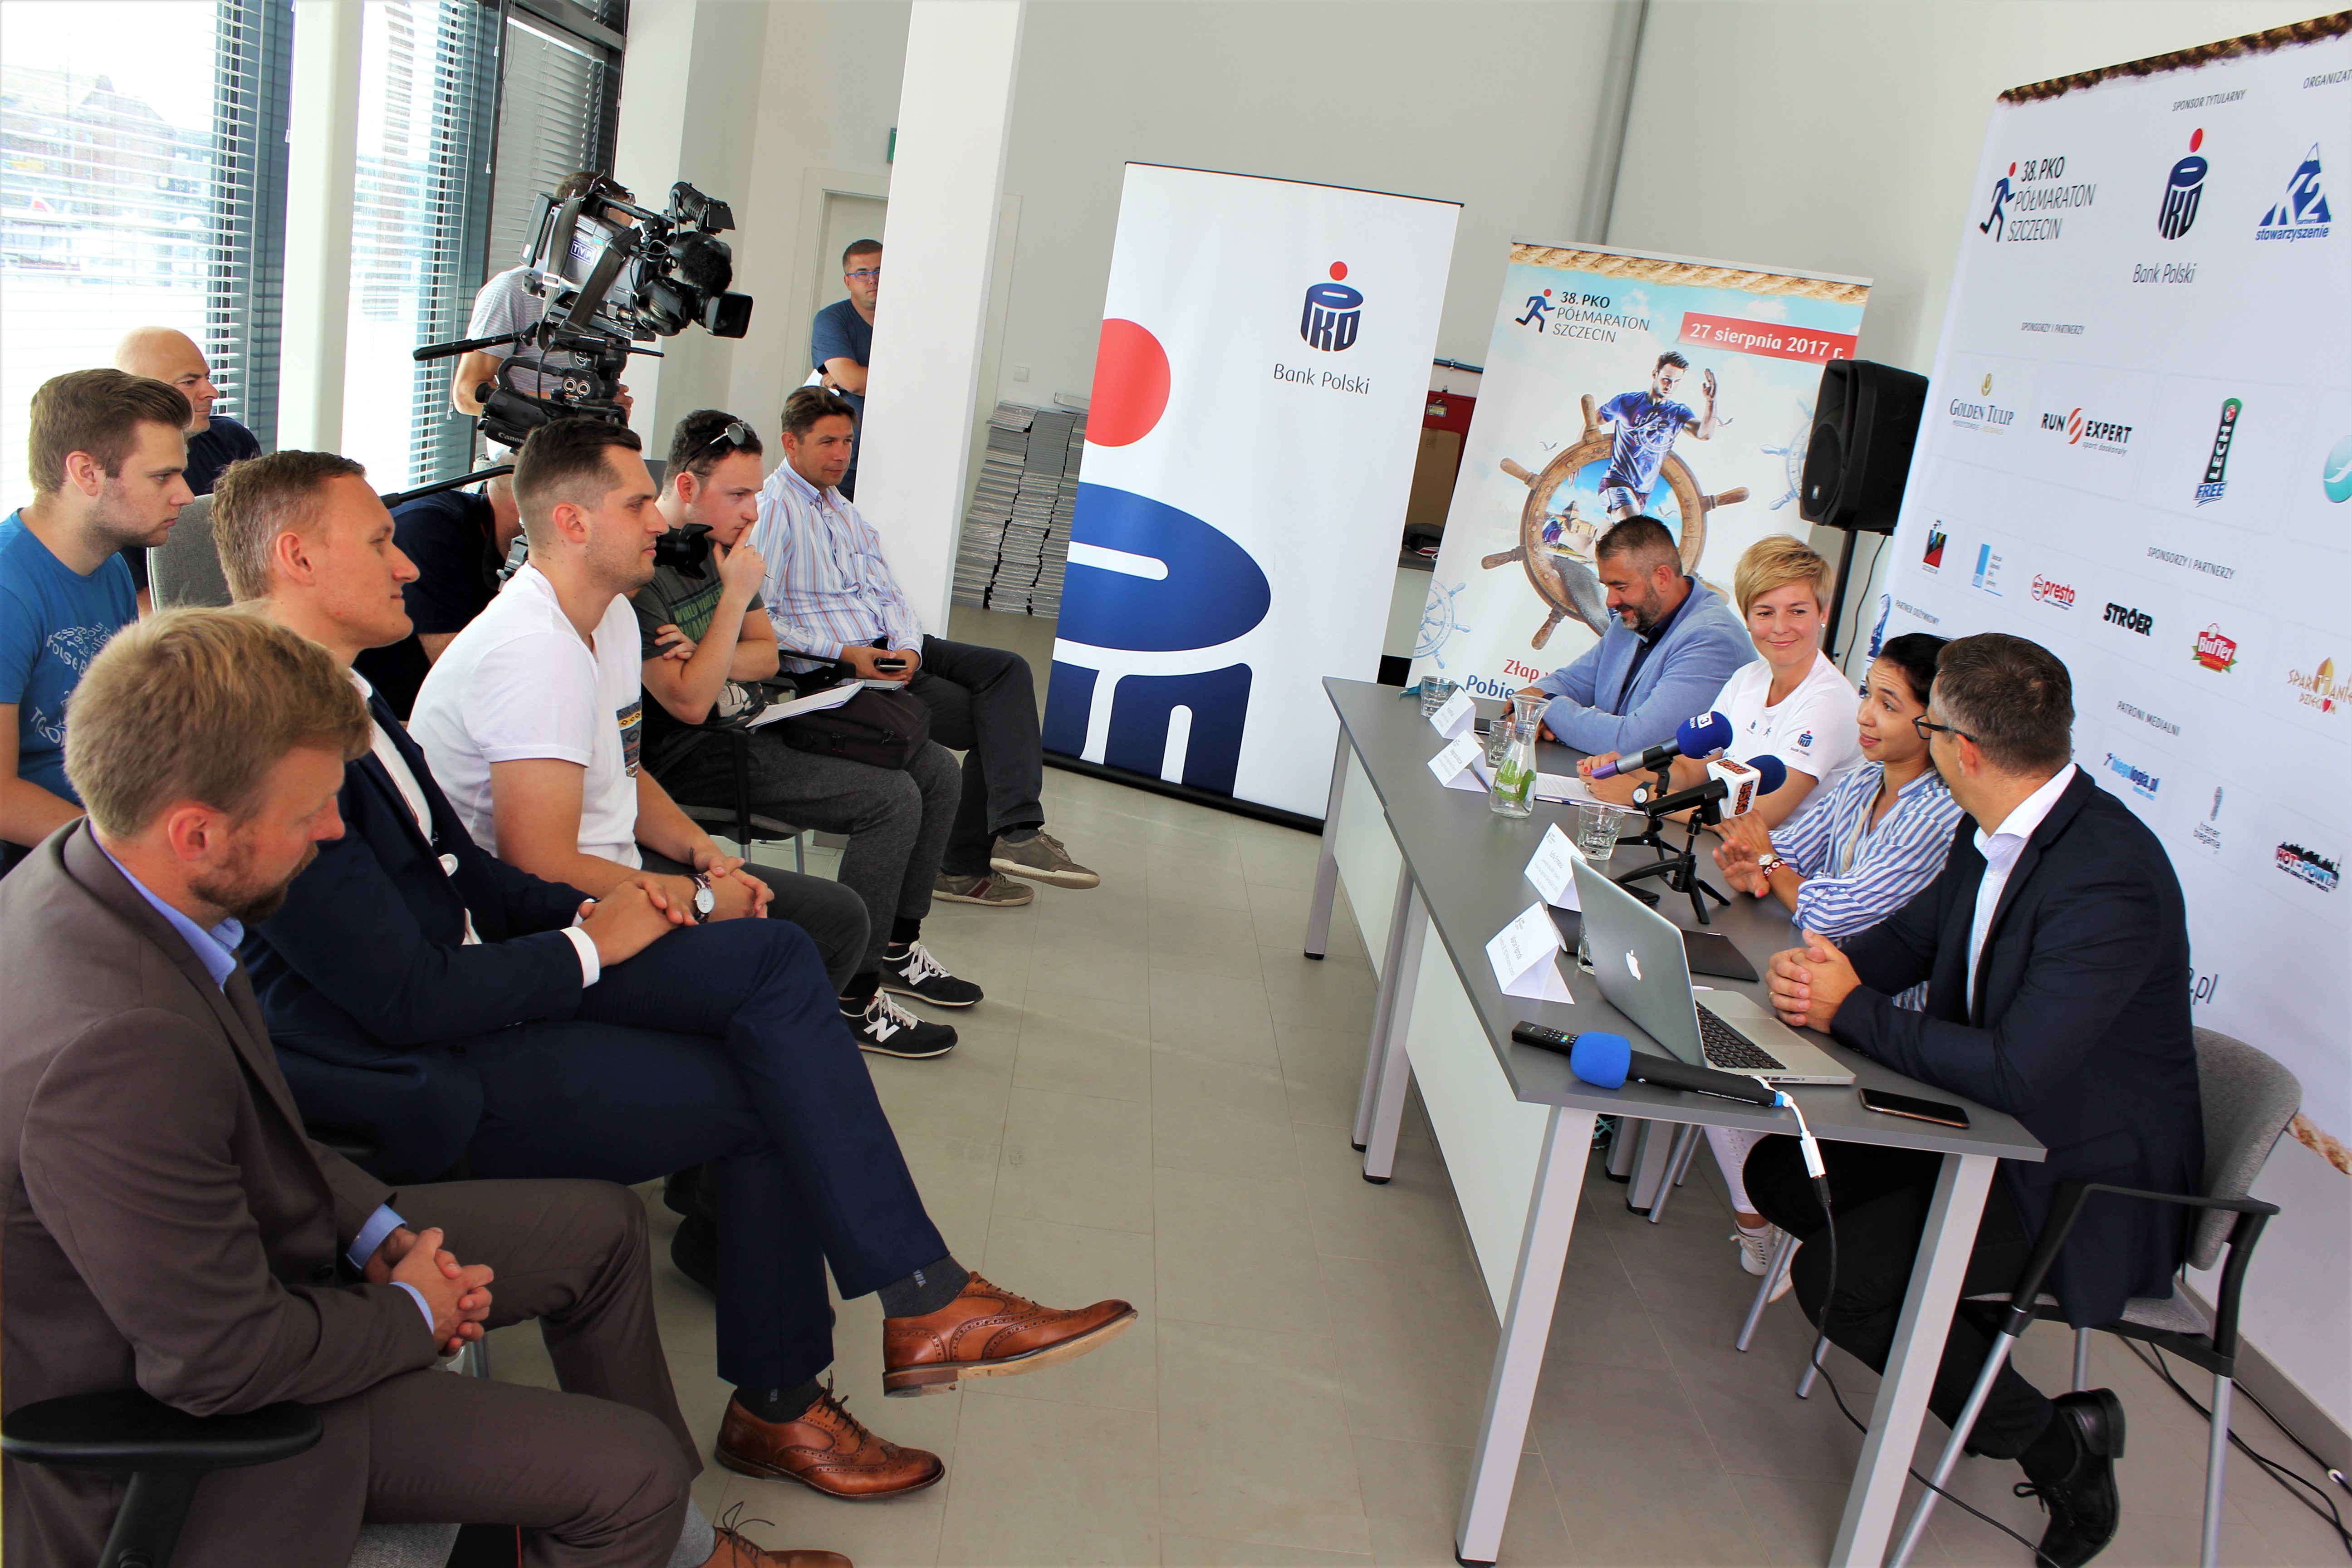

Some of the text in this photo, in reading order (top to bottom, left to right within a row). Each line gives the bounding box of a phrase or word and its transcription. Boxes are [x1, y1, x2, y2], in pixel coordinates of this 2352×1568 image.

[2172, 88, 2247, 112] SPONSOR TYTULARNY
[2021, 156, 2065, 182] 38. PKO
[2014, 183, 2097, 212] PÓŁMARATON
[2007, 217, 2063, 242] SZCZECIN
[2254, 227, 2329, 243] stowarzyszenie
[573, 244, 593, 260] TVP
[2133, 262, 2197, 284] Bank Polski
[1560, 291, 1610, 309] 38. PKO
[1556, 306, 1650, 332] PÓŁMARATON
[1553, 323, 1617, 343] SZCZECIN
[1690, 323, 1711, 338] 27
[1714, 327, 1782, 350] sierpnia
[1786, 337, 1830, 355] 2017
[1274, 363, 1370, 395] Bank Polski
[498, 432, 525, 444] Canon
[2040, 413, 2134, 444] RUN EXPERT
[2208, 425, 2232, 480] LECH
[2195, 482, 2227, 499] FREE
[2147, 546, 2188, 567] SPONSORZY
[2192, 559, 2235, 580] PARTNERZY
[2041, 581, 2075, 603] presto
[2198, 636, 2234, 662] Buffet
[1503, 659, 1539, 683] Złap
[2117, 701, 2181, 737] PATRONI MEDIALNI
[2193, 828, 2220, 849] biegania
[2199, 821, 2221, 837] trener
